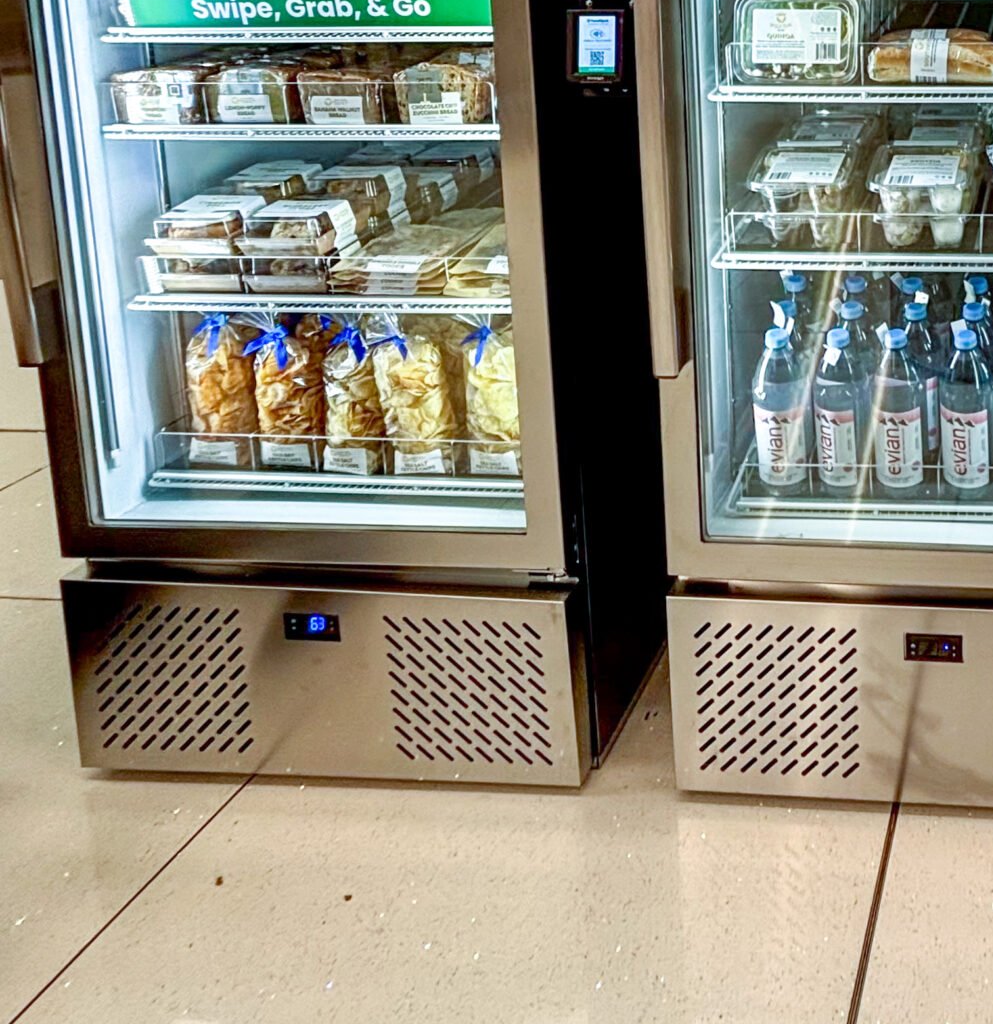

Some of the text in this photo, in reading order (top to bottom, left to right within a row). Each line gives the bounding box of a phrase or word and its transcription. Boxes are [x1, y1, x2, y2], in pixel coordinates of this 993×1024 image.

[769, 424, 785, 474] evian
[819, 422, 835, 473] evian
[885, 426, 902, 476] evian
[952, 427, 967, 475] evian
[311, 617, 325, 630] 63
